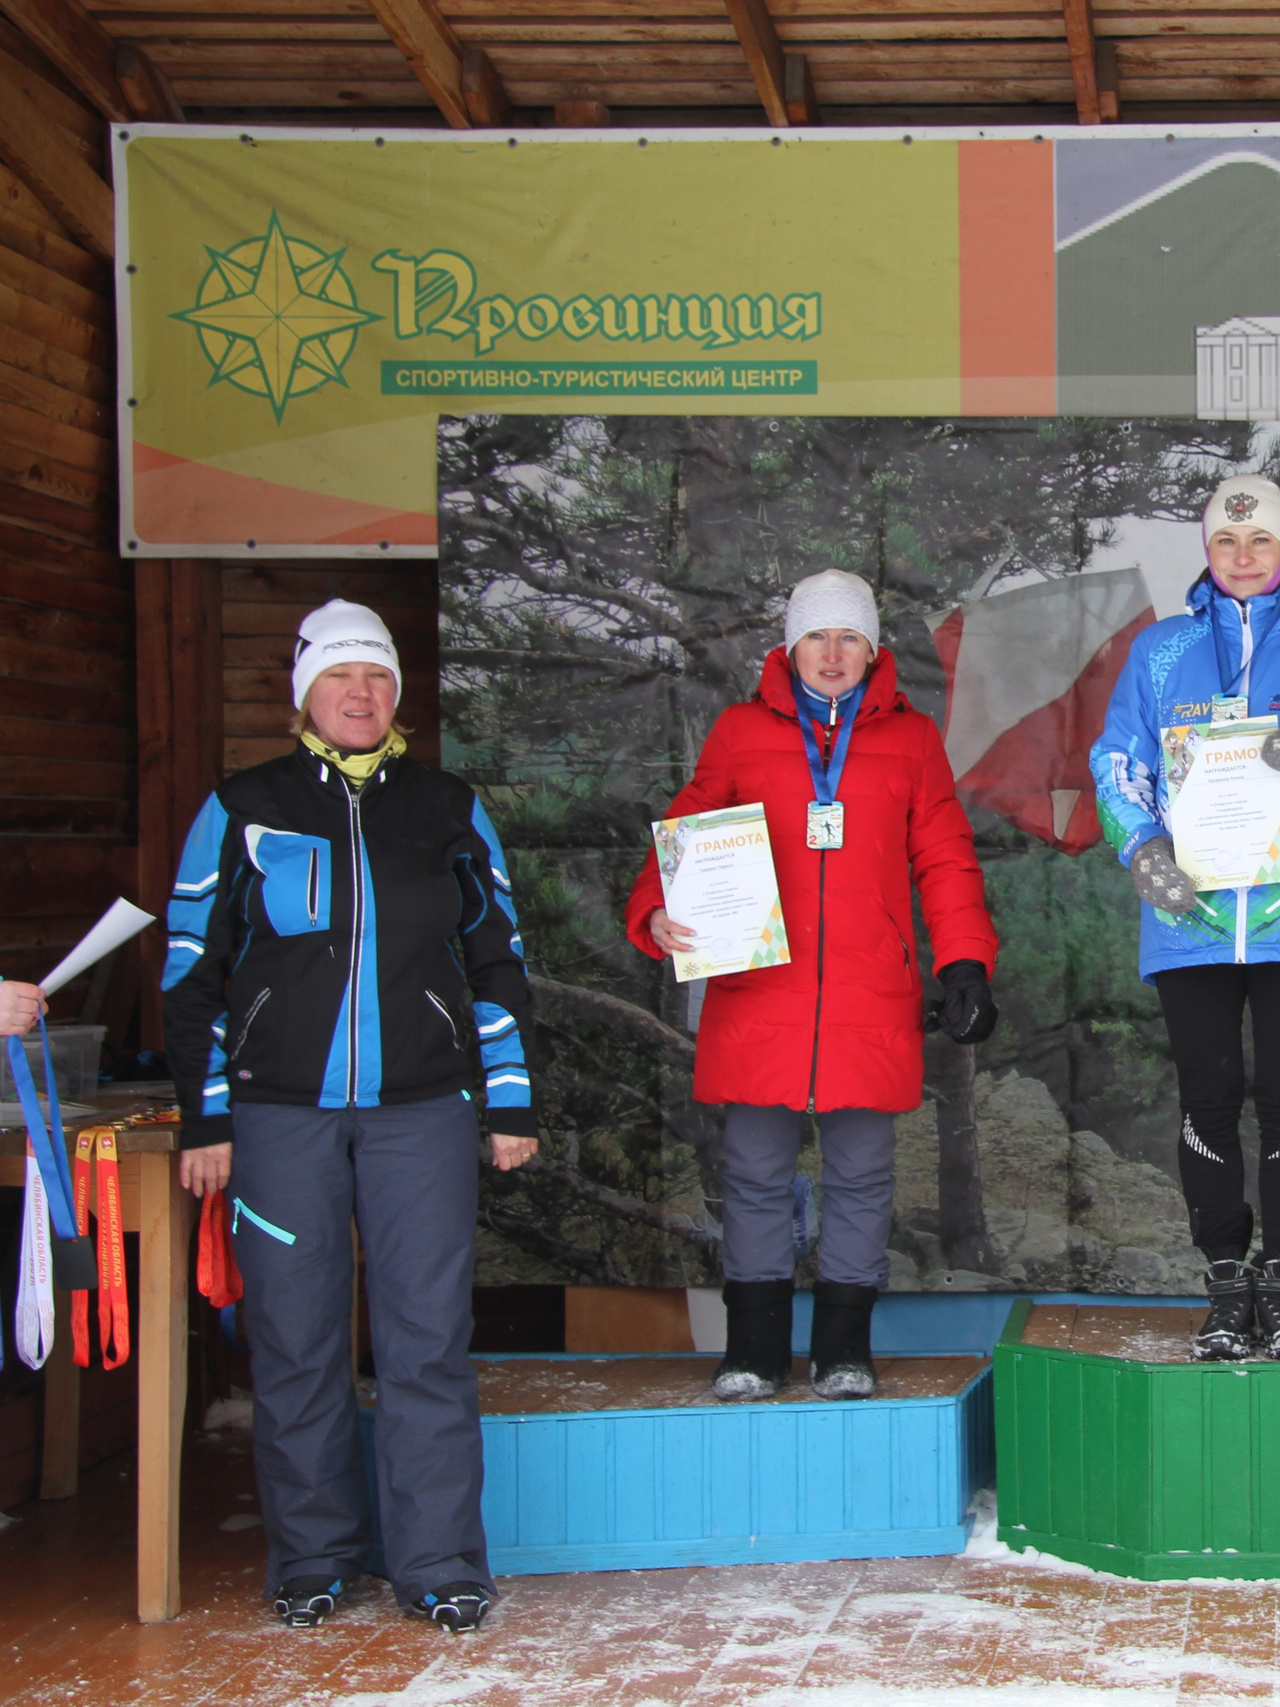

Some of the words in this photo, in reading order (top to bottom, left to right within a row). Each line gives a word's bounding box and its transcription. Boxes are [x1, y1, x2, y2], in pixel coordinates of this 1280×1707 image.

[370, 248, 822, 356] Провинция
[395, 366, 726, 389] СПОРТИВНО-ТУРИСТИЧЕСКИЙ
[731, 367, 804, 390] ЦЕНТР
[1172, 702, 1211, 719] RAY
[1205, 747, 1264, 765] ГРАМО
[695, 832, 765, 855] ГРАМОТА
[809, 835, 817, 845] 2
[33, 1174, 44, 1241] ЧЕЛЯБИНСКАЯ
[76, 1176, 86, 1236] ЧЕЛЯБИНСК
[107, 1176, 119, 1243] ЧЕЛЯБИНСКАЯ
[37, 1242, 47, 1285] ОБЛАСТЬ
[112, 1245, 123, 1287] ОБЛАСТЬ
